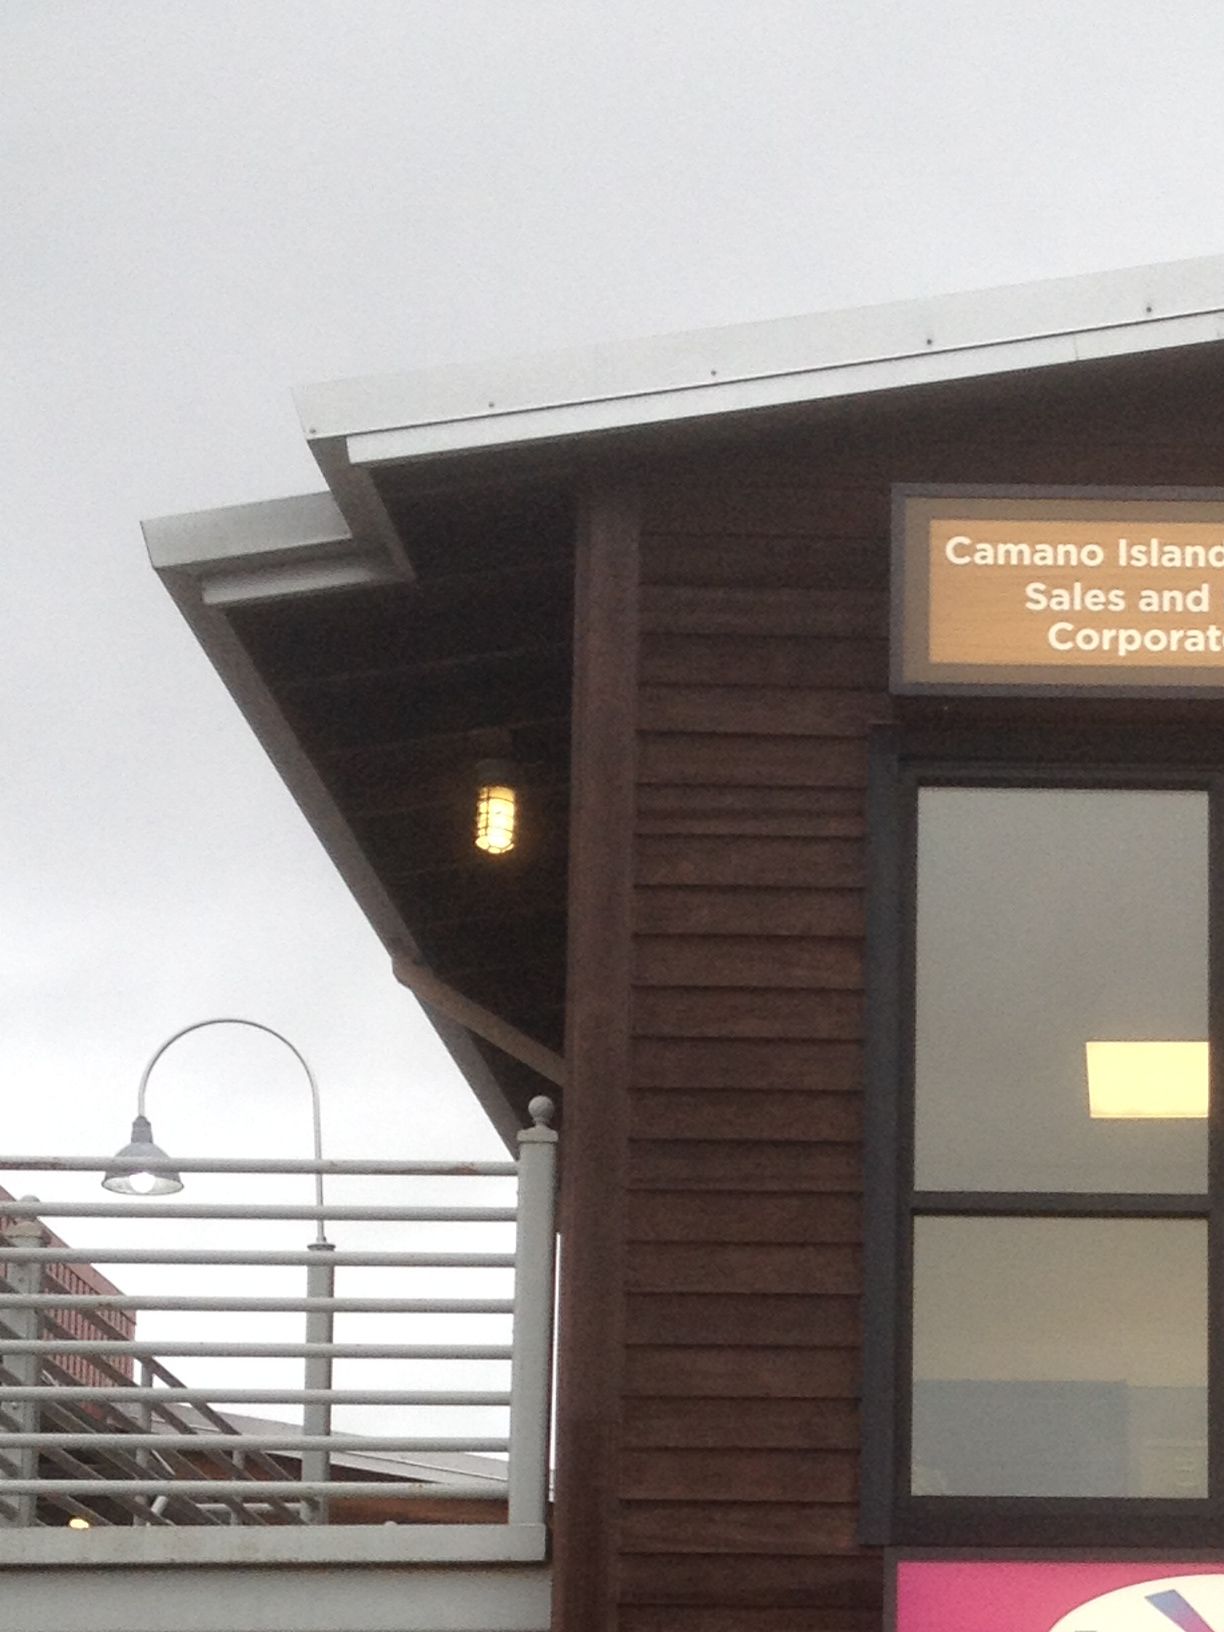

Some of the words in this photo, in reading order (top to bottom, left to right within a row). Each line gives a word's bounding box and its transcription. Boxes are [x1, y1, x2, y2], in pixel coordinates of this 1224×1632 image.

[946, 536, 1104, 568] Camano
[1026, 583, 1125, 611] Sales
[1139, 584, 1209, 612] and
